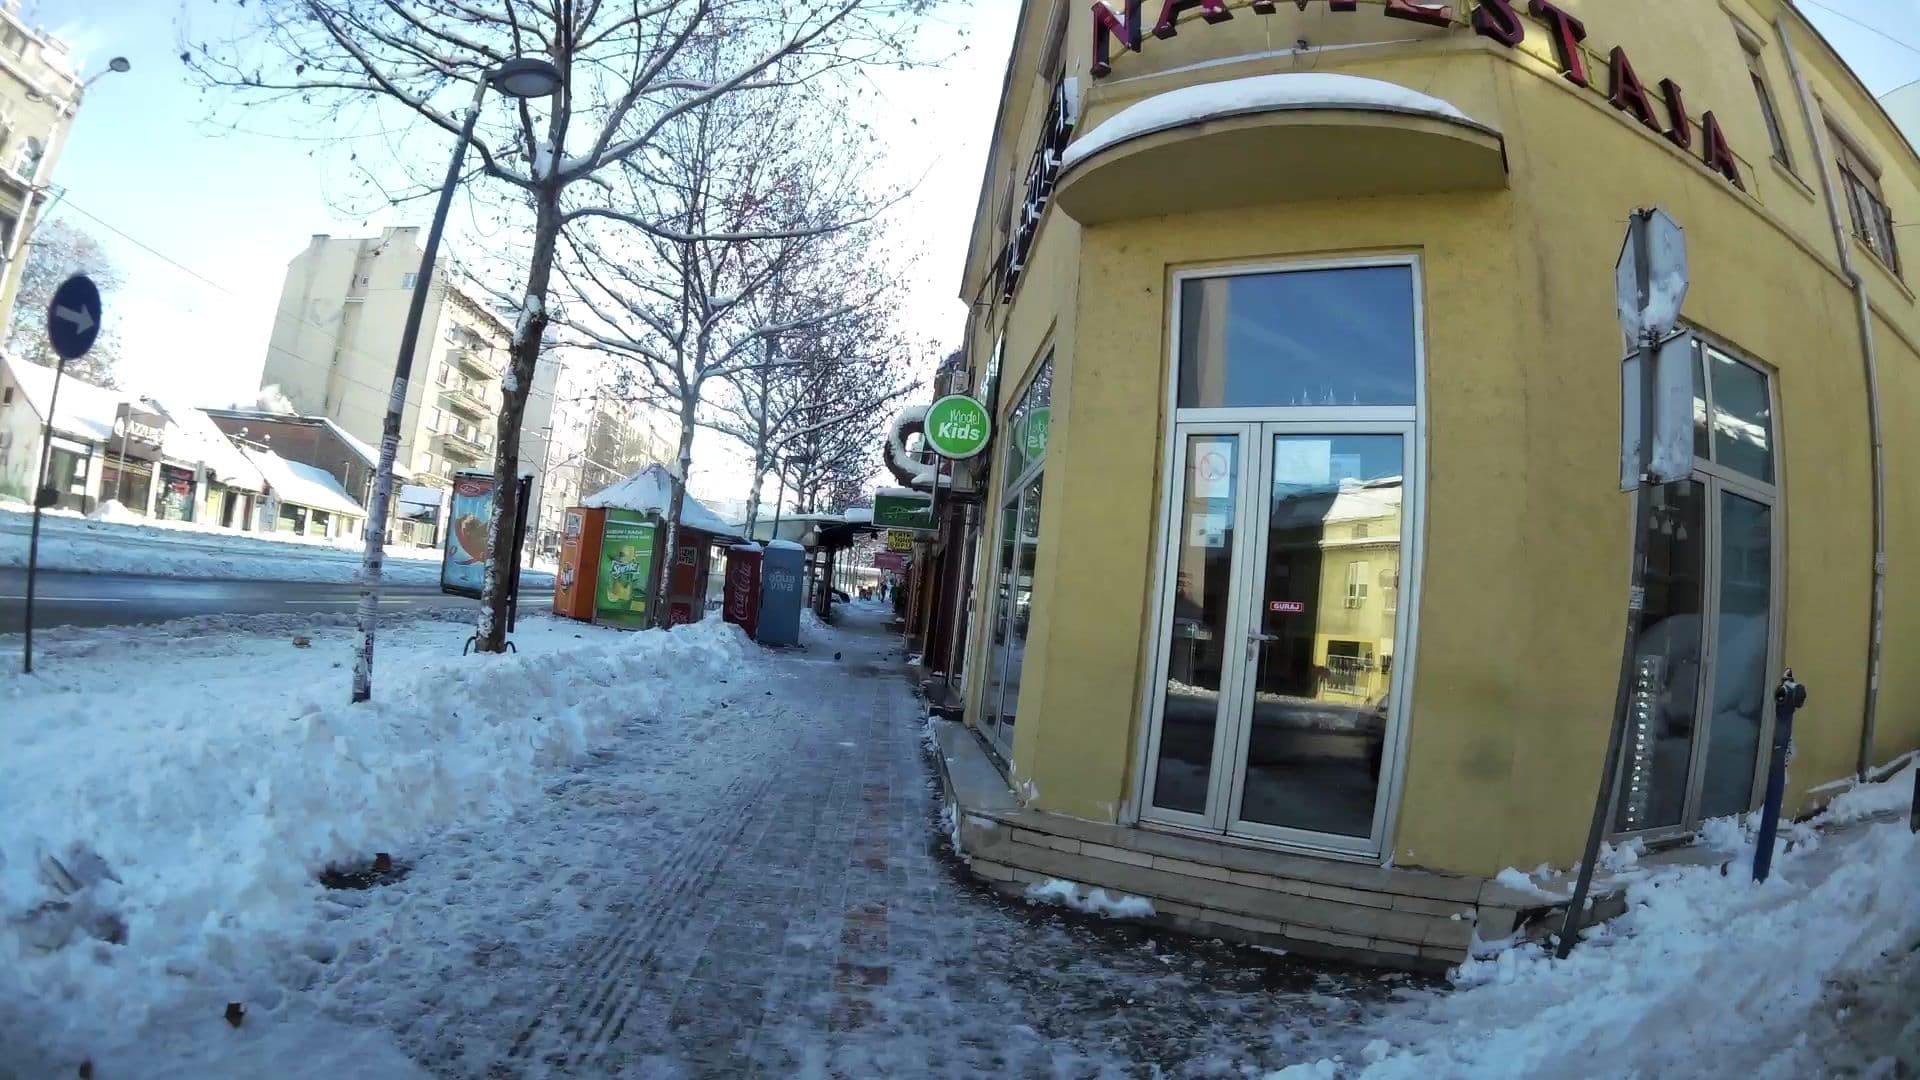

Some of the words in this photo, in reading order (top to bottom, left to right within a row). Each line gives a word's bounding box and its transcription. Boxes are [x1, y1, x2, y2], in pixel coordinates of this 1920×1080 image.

[950, 408, 980, 425] Model
[938, 421, 981, 441] Kids
[611, 562, 640, 578] Sprite
